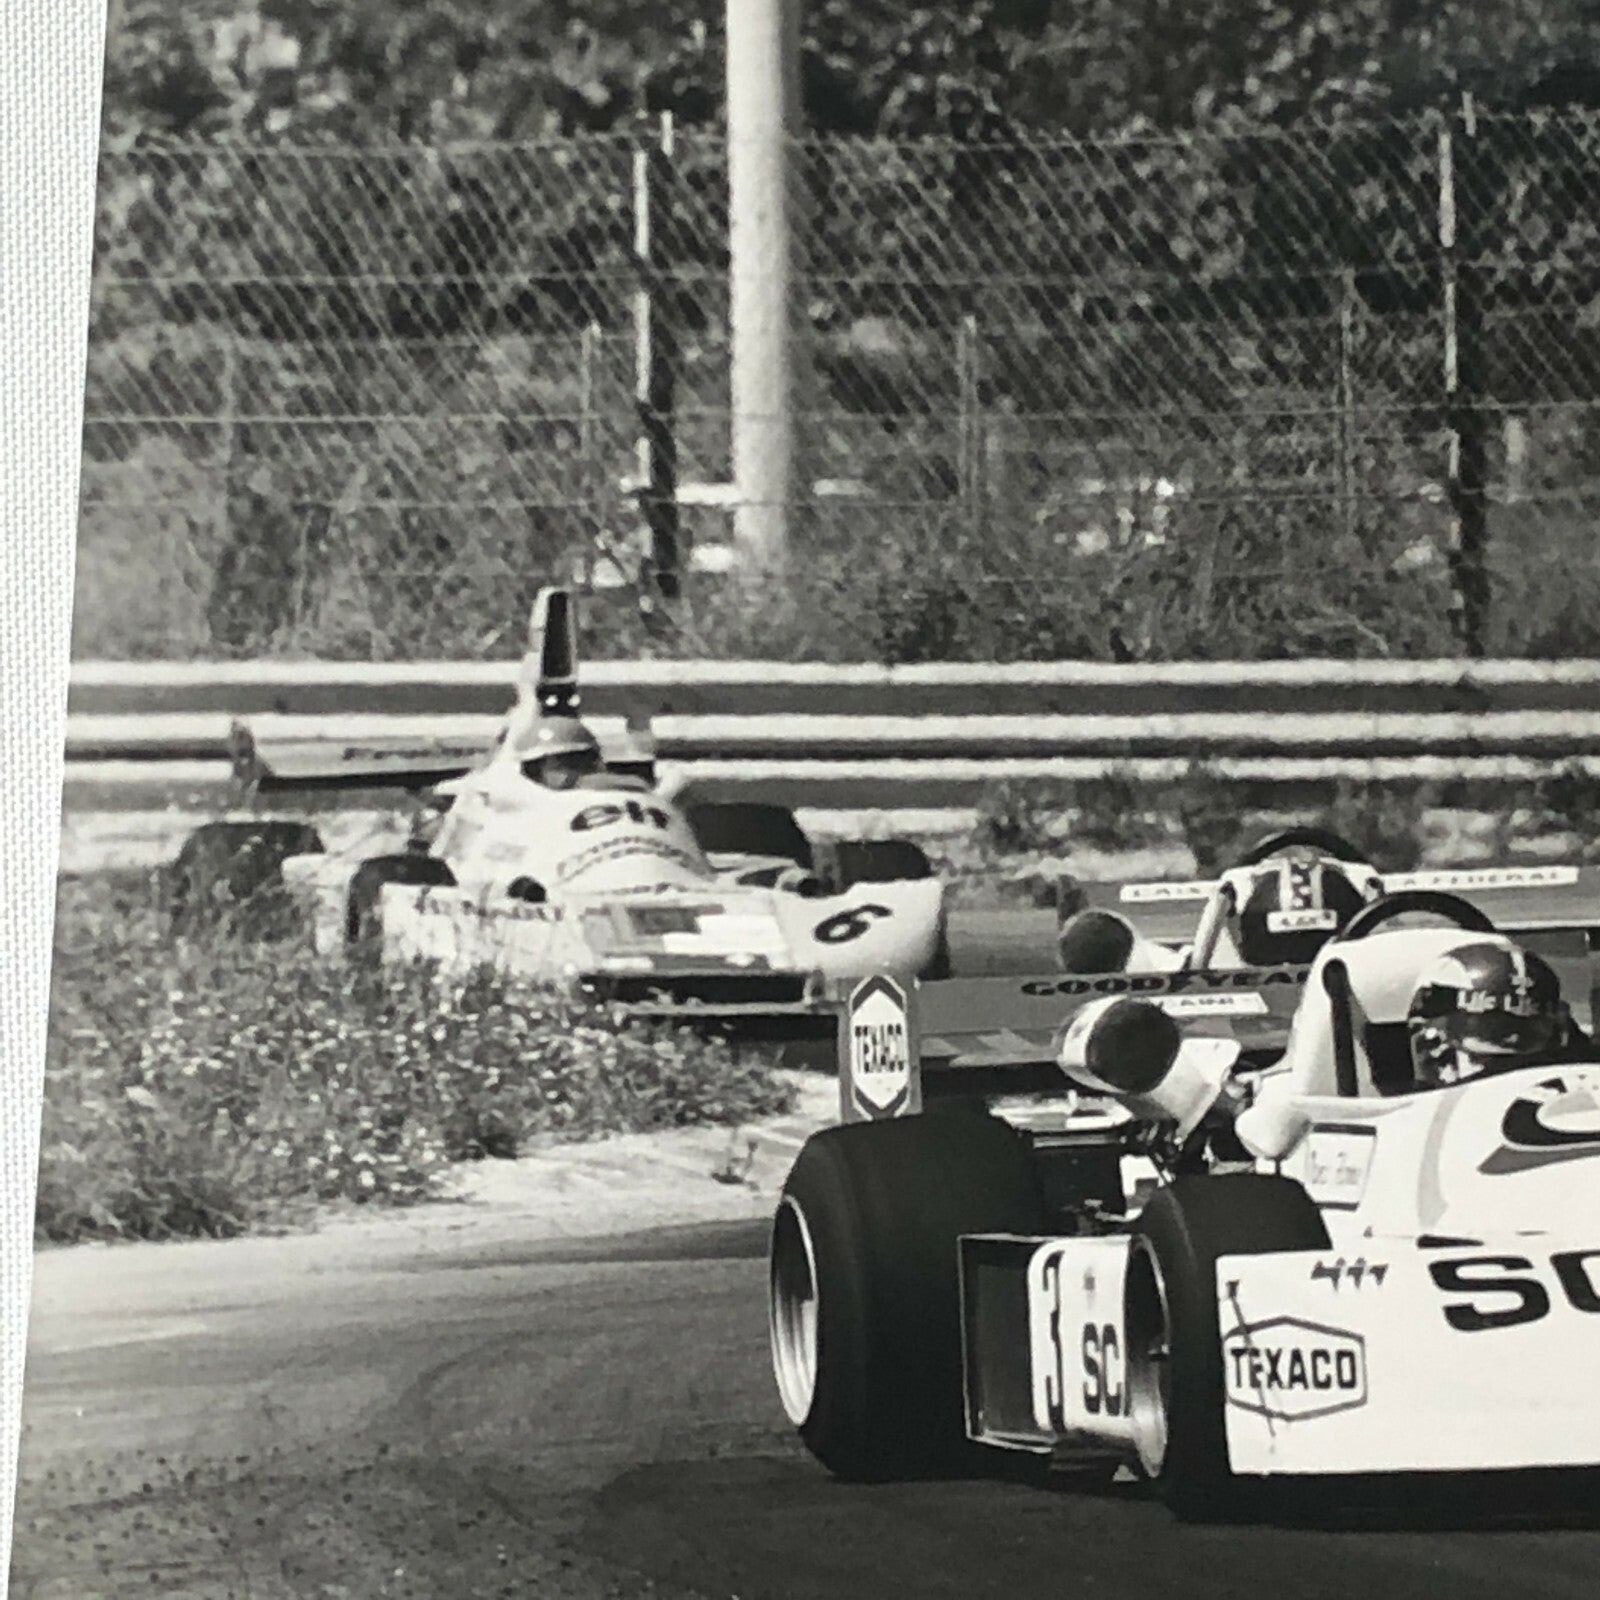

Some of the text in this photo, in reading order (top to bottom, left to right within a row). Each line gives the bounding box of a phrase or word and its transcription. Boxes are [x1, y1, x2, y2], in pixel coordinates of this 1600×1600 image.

[814, 904, 892, 944] 6
[1083, 1322, 1130, 1417] SC
[1230, 1348, 1358, 1390] TEXACO
